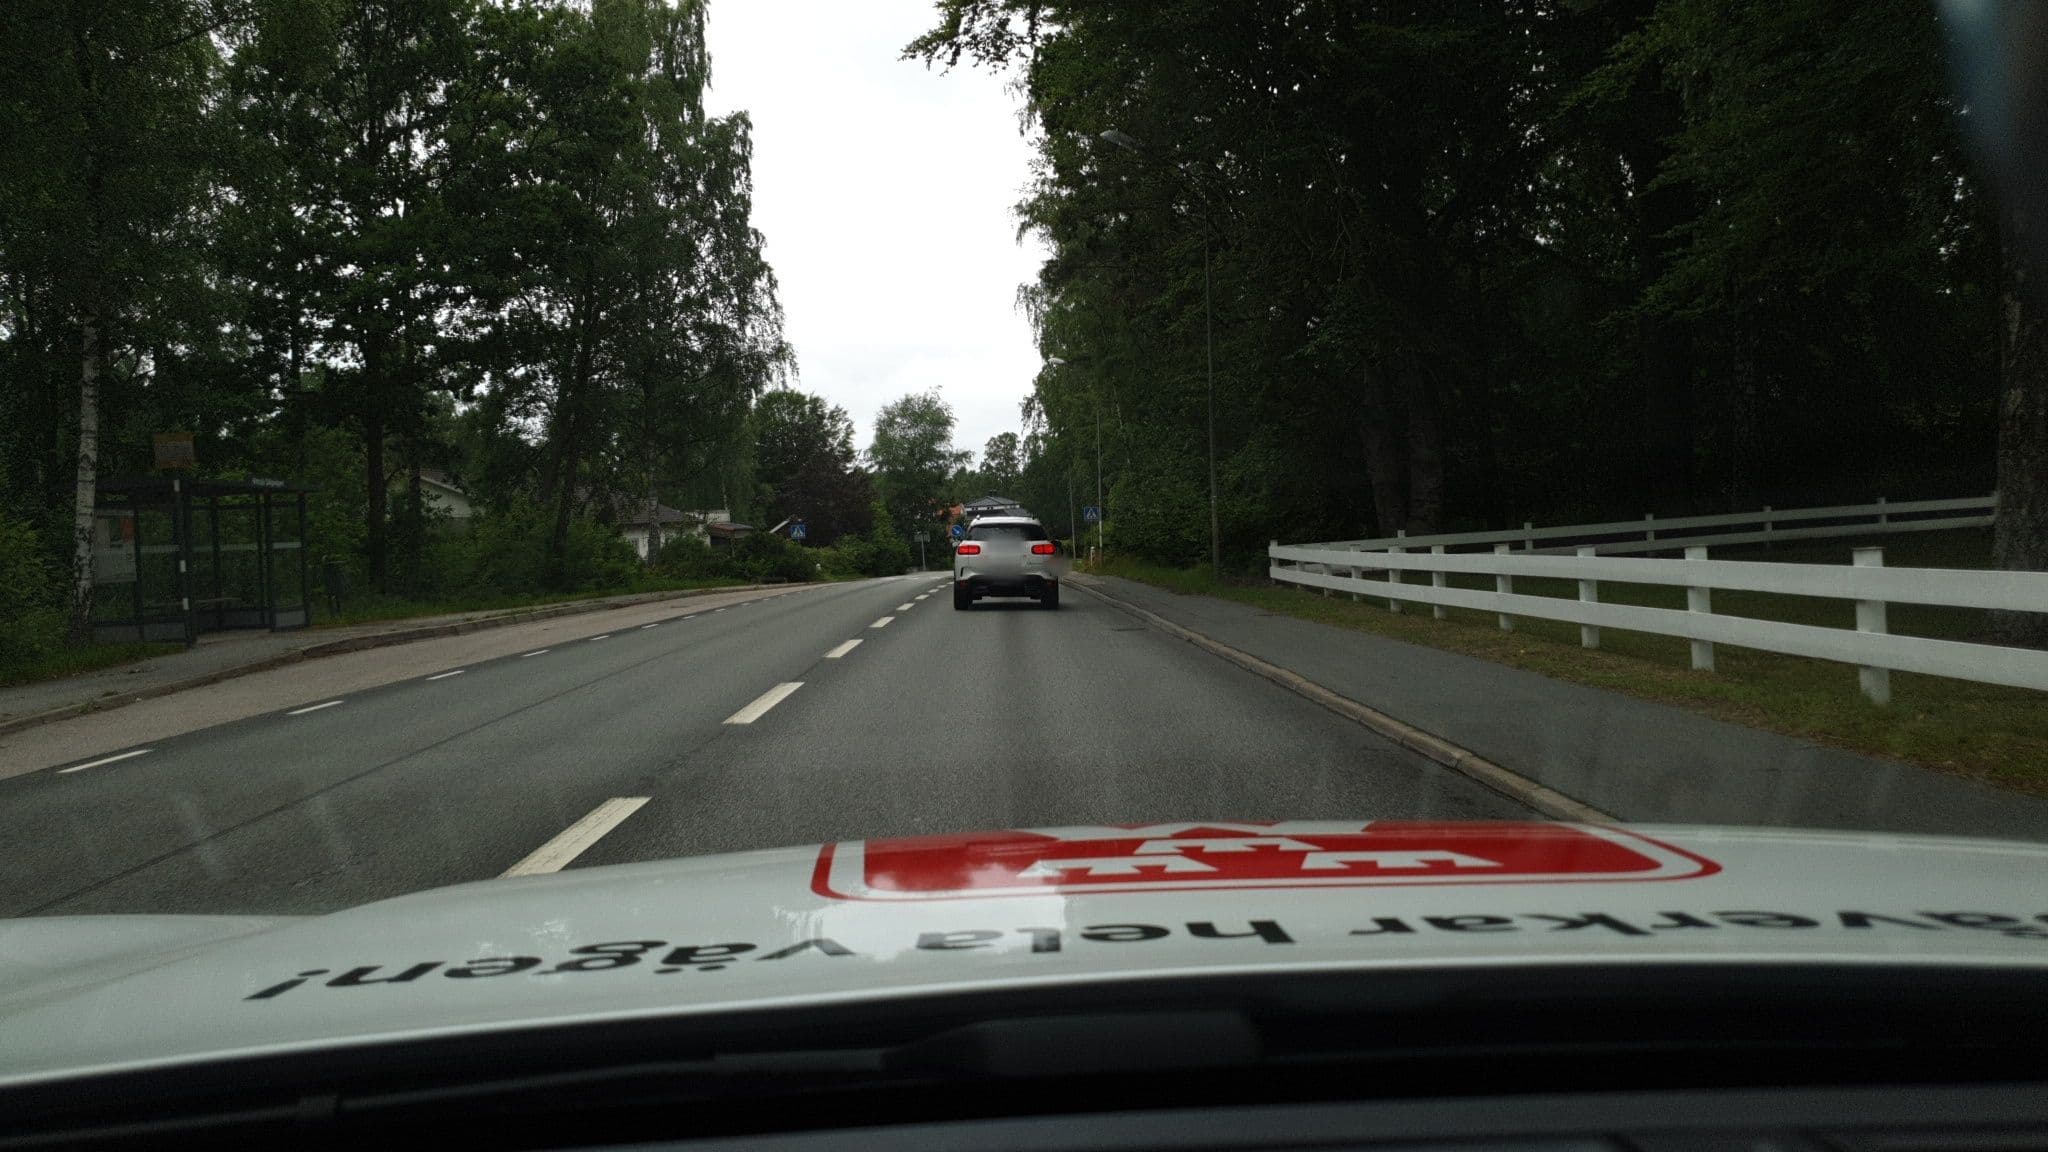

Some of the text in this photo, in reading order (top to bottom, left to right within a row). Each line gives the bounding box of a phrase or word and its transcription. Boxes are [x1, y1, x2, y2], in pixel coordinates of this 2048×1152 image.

[243, 910, 2048, 1001] åverkar hela vägen!
